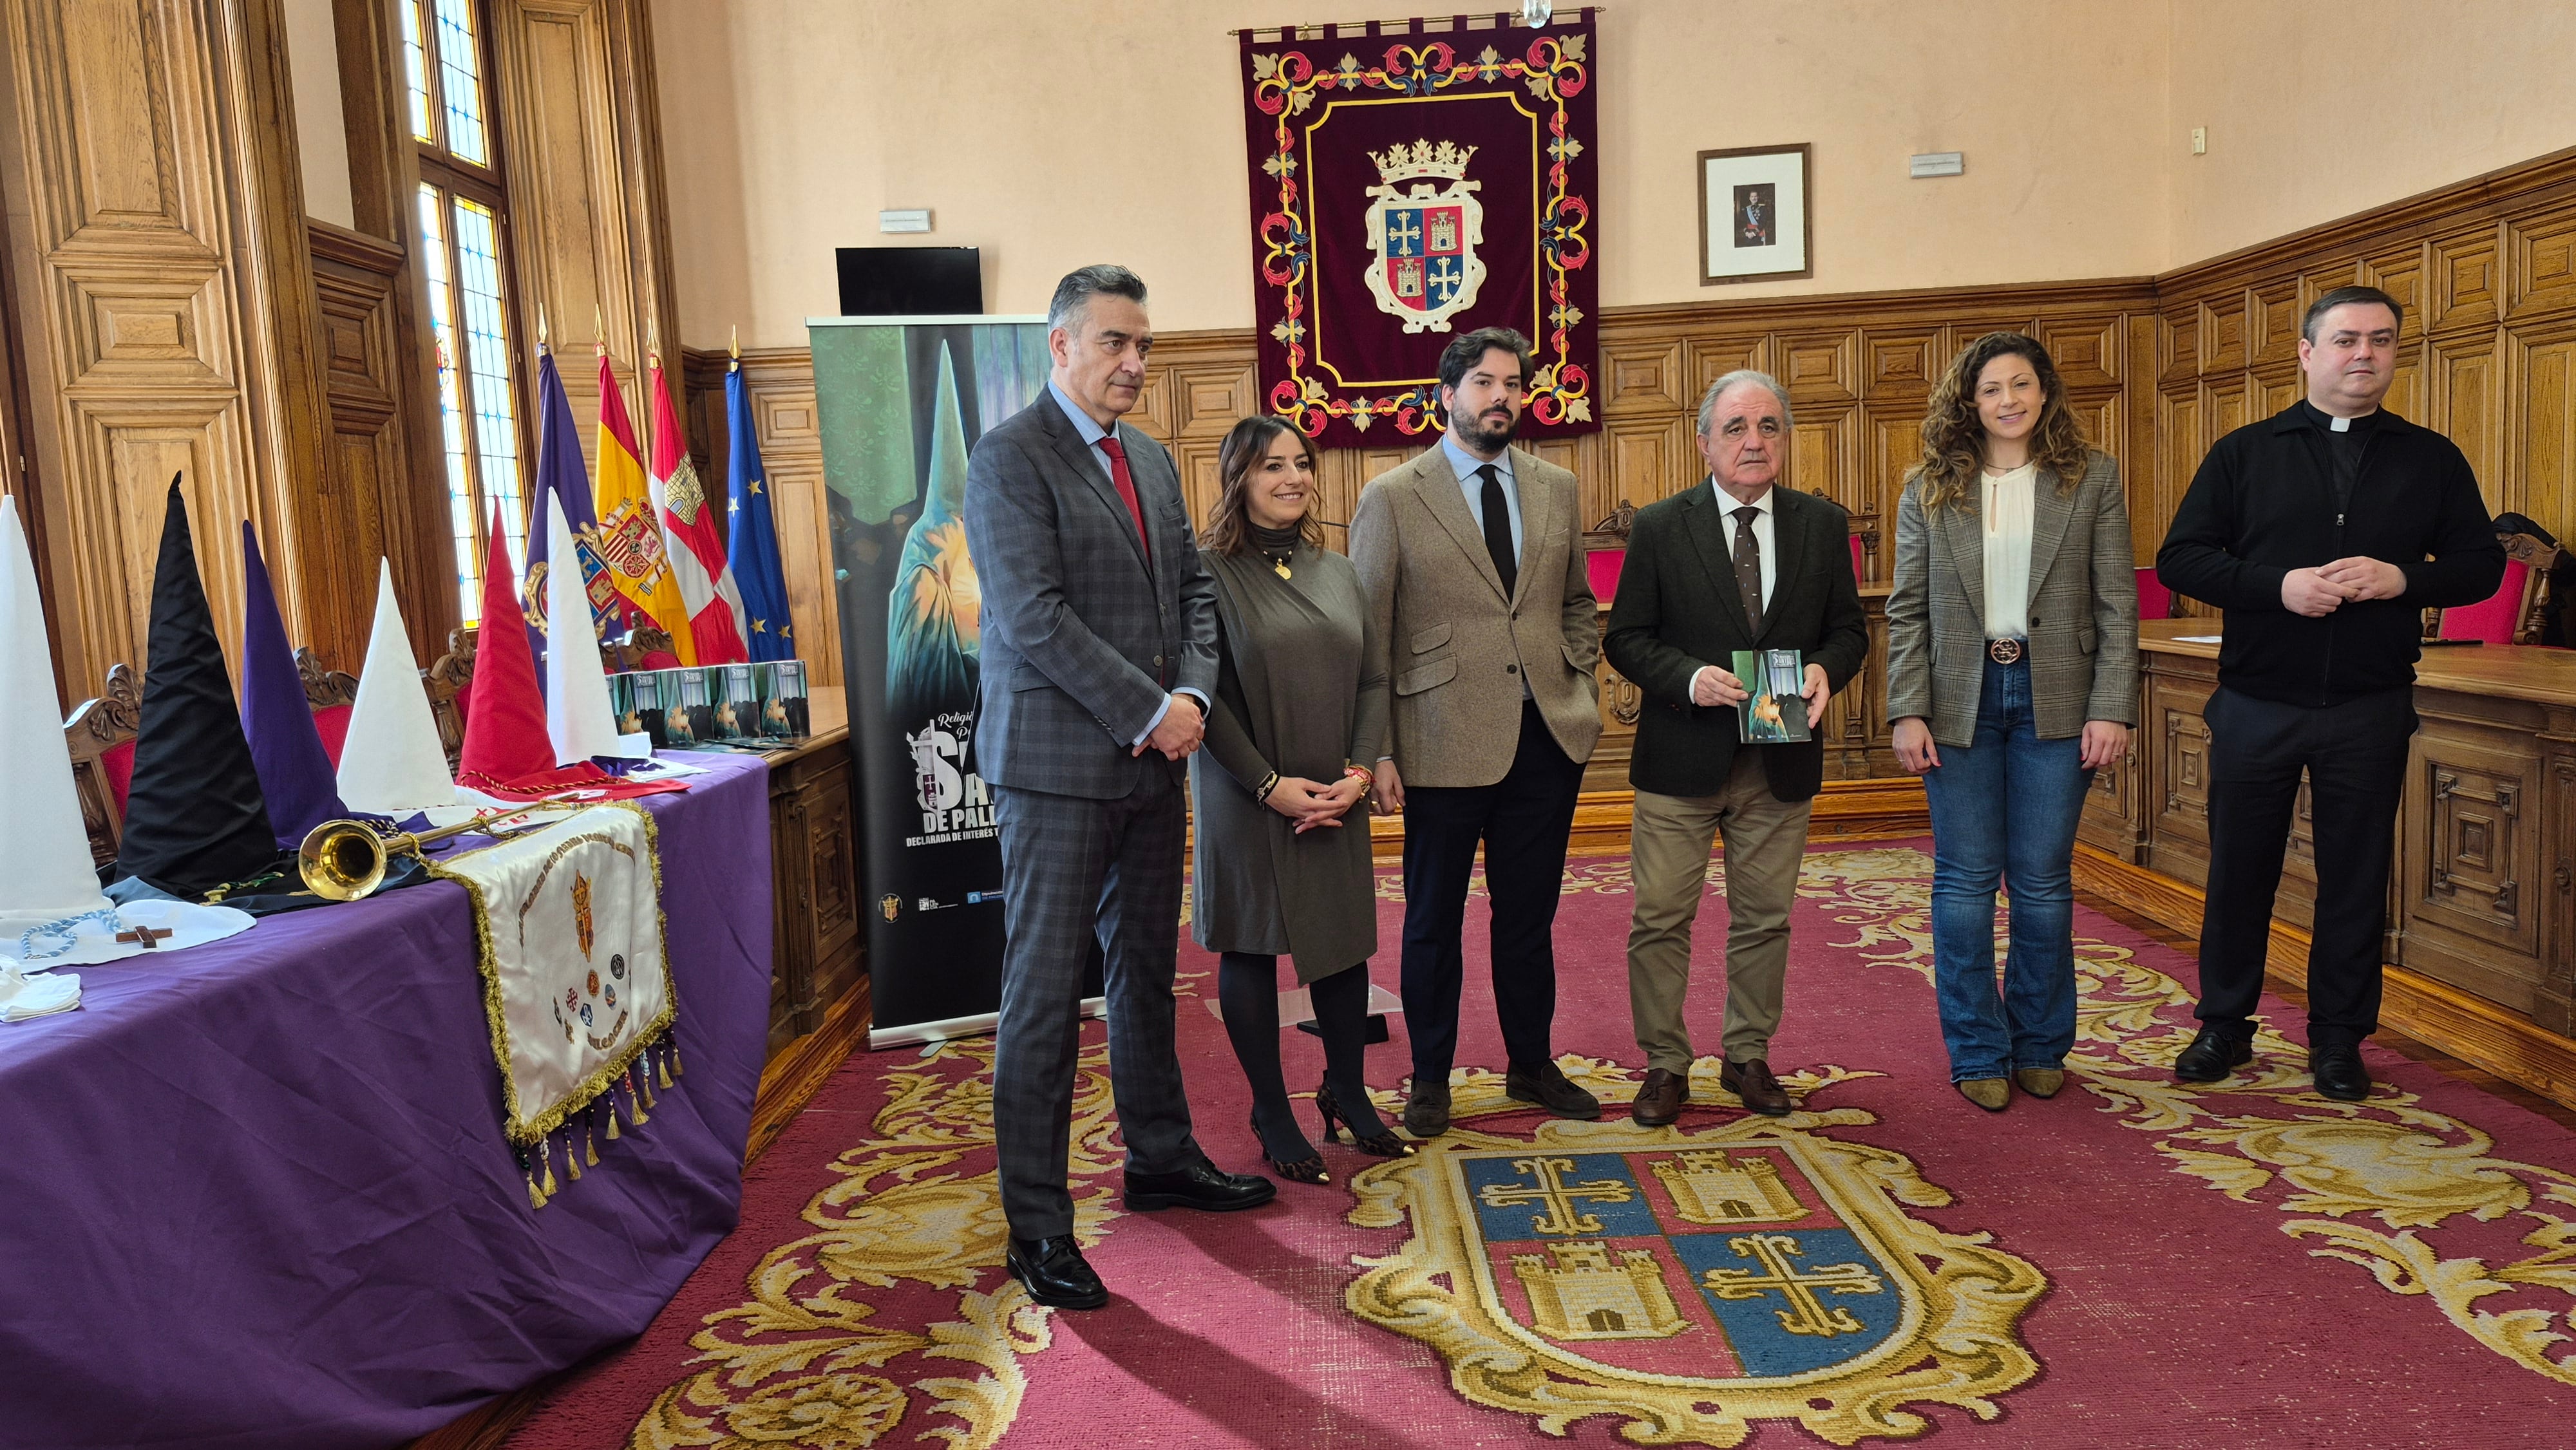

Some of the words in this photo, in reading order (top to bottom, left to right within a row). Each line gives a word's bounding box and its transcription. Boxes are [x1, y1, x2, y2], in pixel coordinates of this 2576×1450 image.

[923, 810, 949, 833] DE
[906, 833, 951, 847] DECLARADA
[952, 831, 962, 842] DE
[963, 827, 993, 840] INTERÉS
